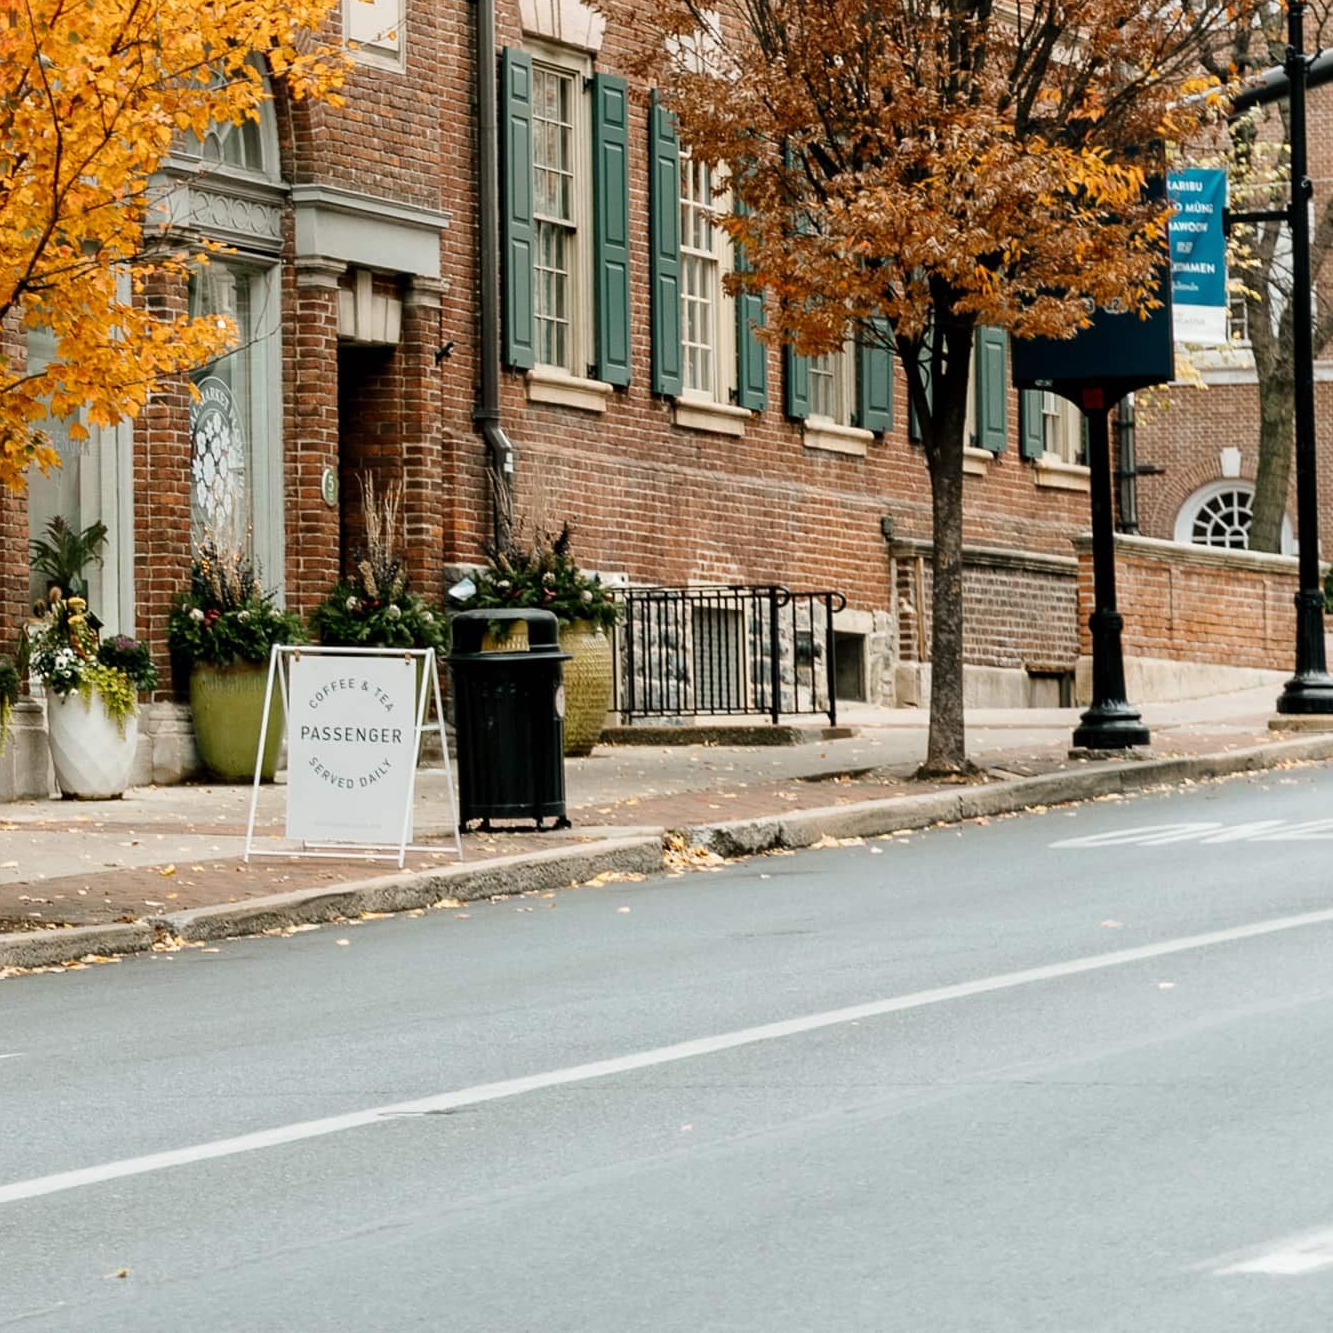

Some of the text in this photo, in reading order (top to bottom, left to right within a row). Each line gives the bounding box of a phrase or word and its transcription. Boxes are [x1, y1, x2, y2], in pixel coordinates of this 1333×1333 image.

[308, 678, 395, 713] COFFEE & TEA
[300, 725, 403, 744] PASSENGER
[308, 756, 392, 789] SERVED DAILY
